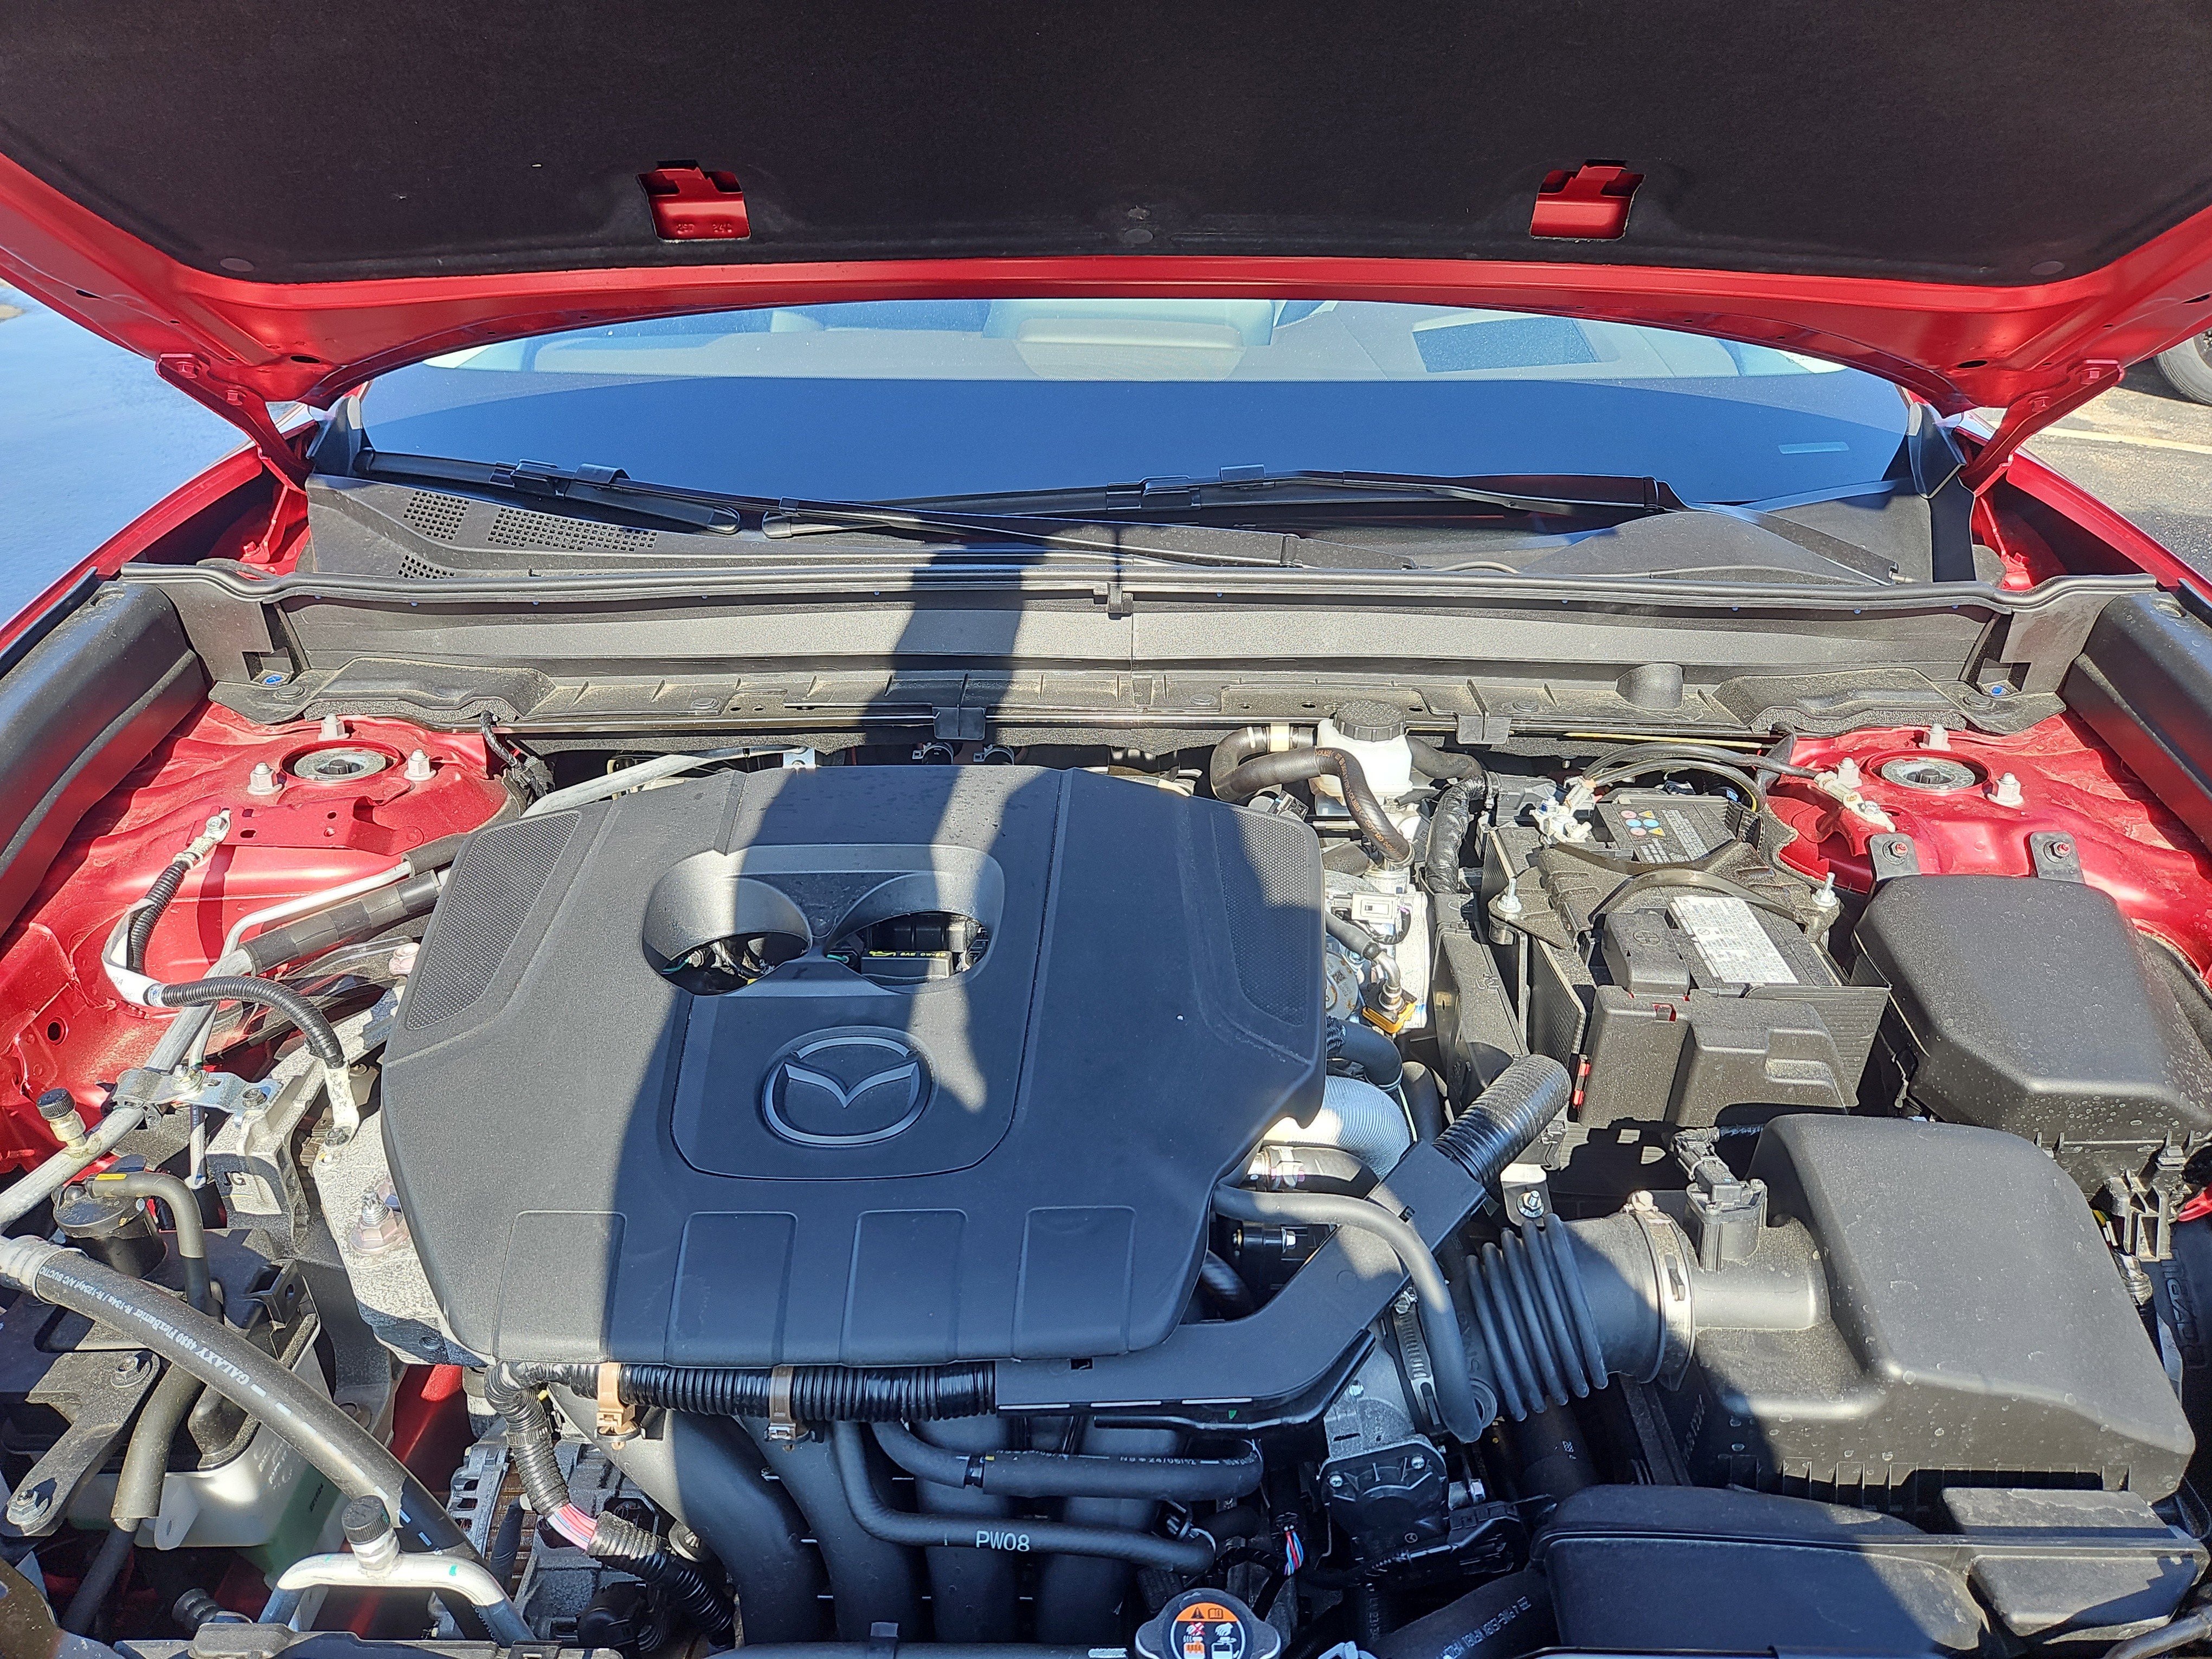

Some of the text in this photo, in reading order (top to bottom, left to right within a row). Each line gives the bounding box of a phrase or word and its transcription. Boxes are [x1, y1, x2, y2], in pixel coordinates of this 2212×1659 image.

[62, 1275, 78, 1287] A/C
[108, 1295, 134, 1315] R-134a
[133, 1308, 178, 1340] FlexBarrier
[175, 1333, 197, 1350] 4880
[195, 1347, 250, 1385] GALAXY
[976, 1530, 1030, 1552] PW08
